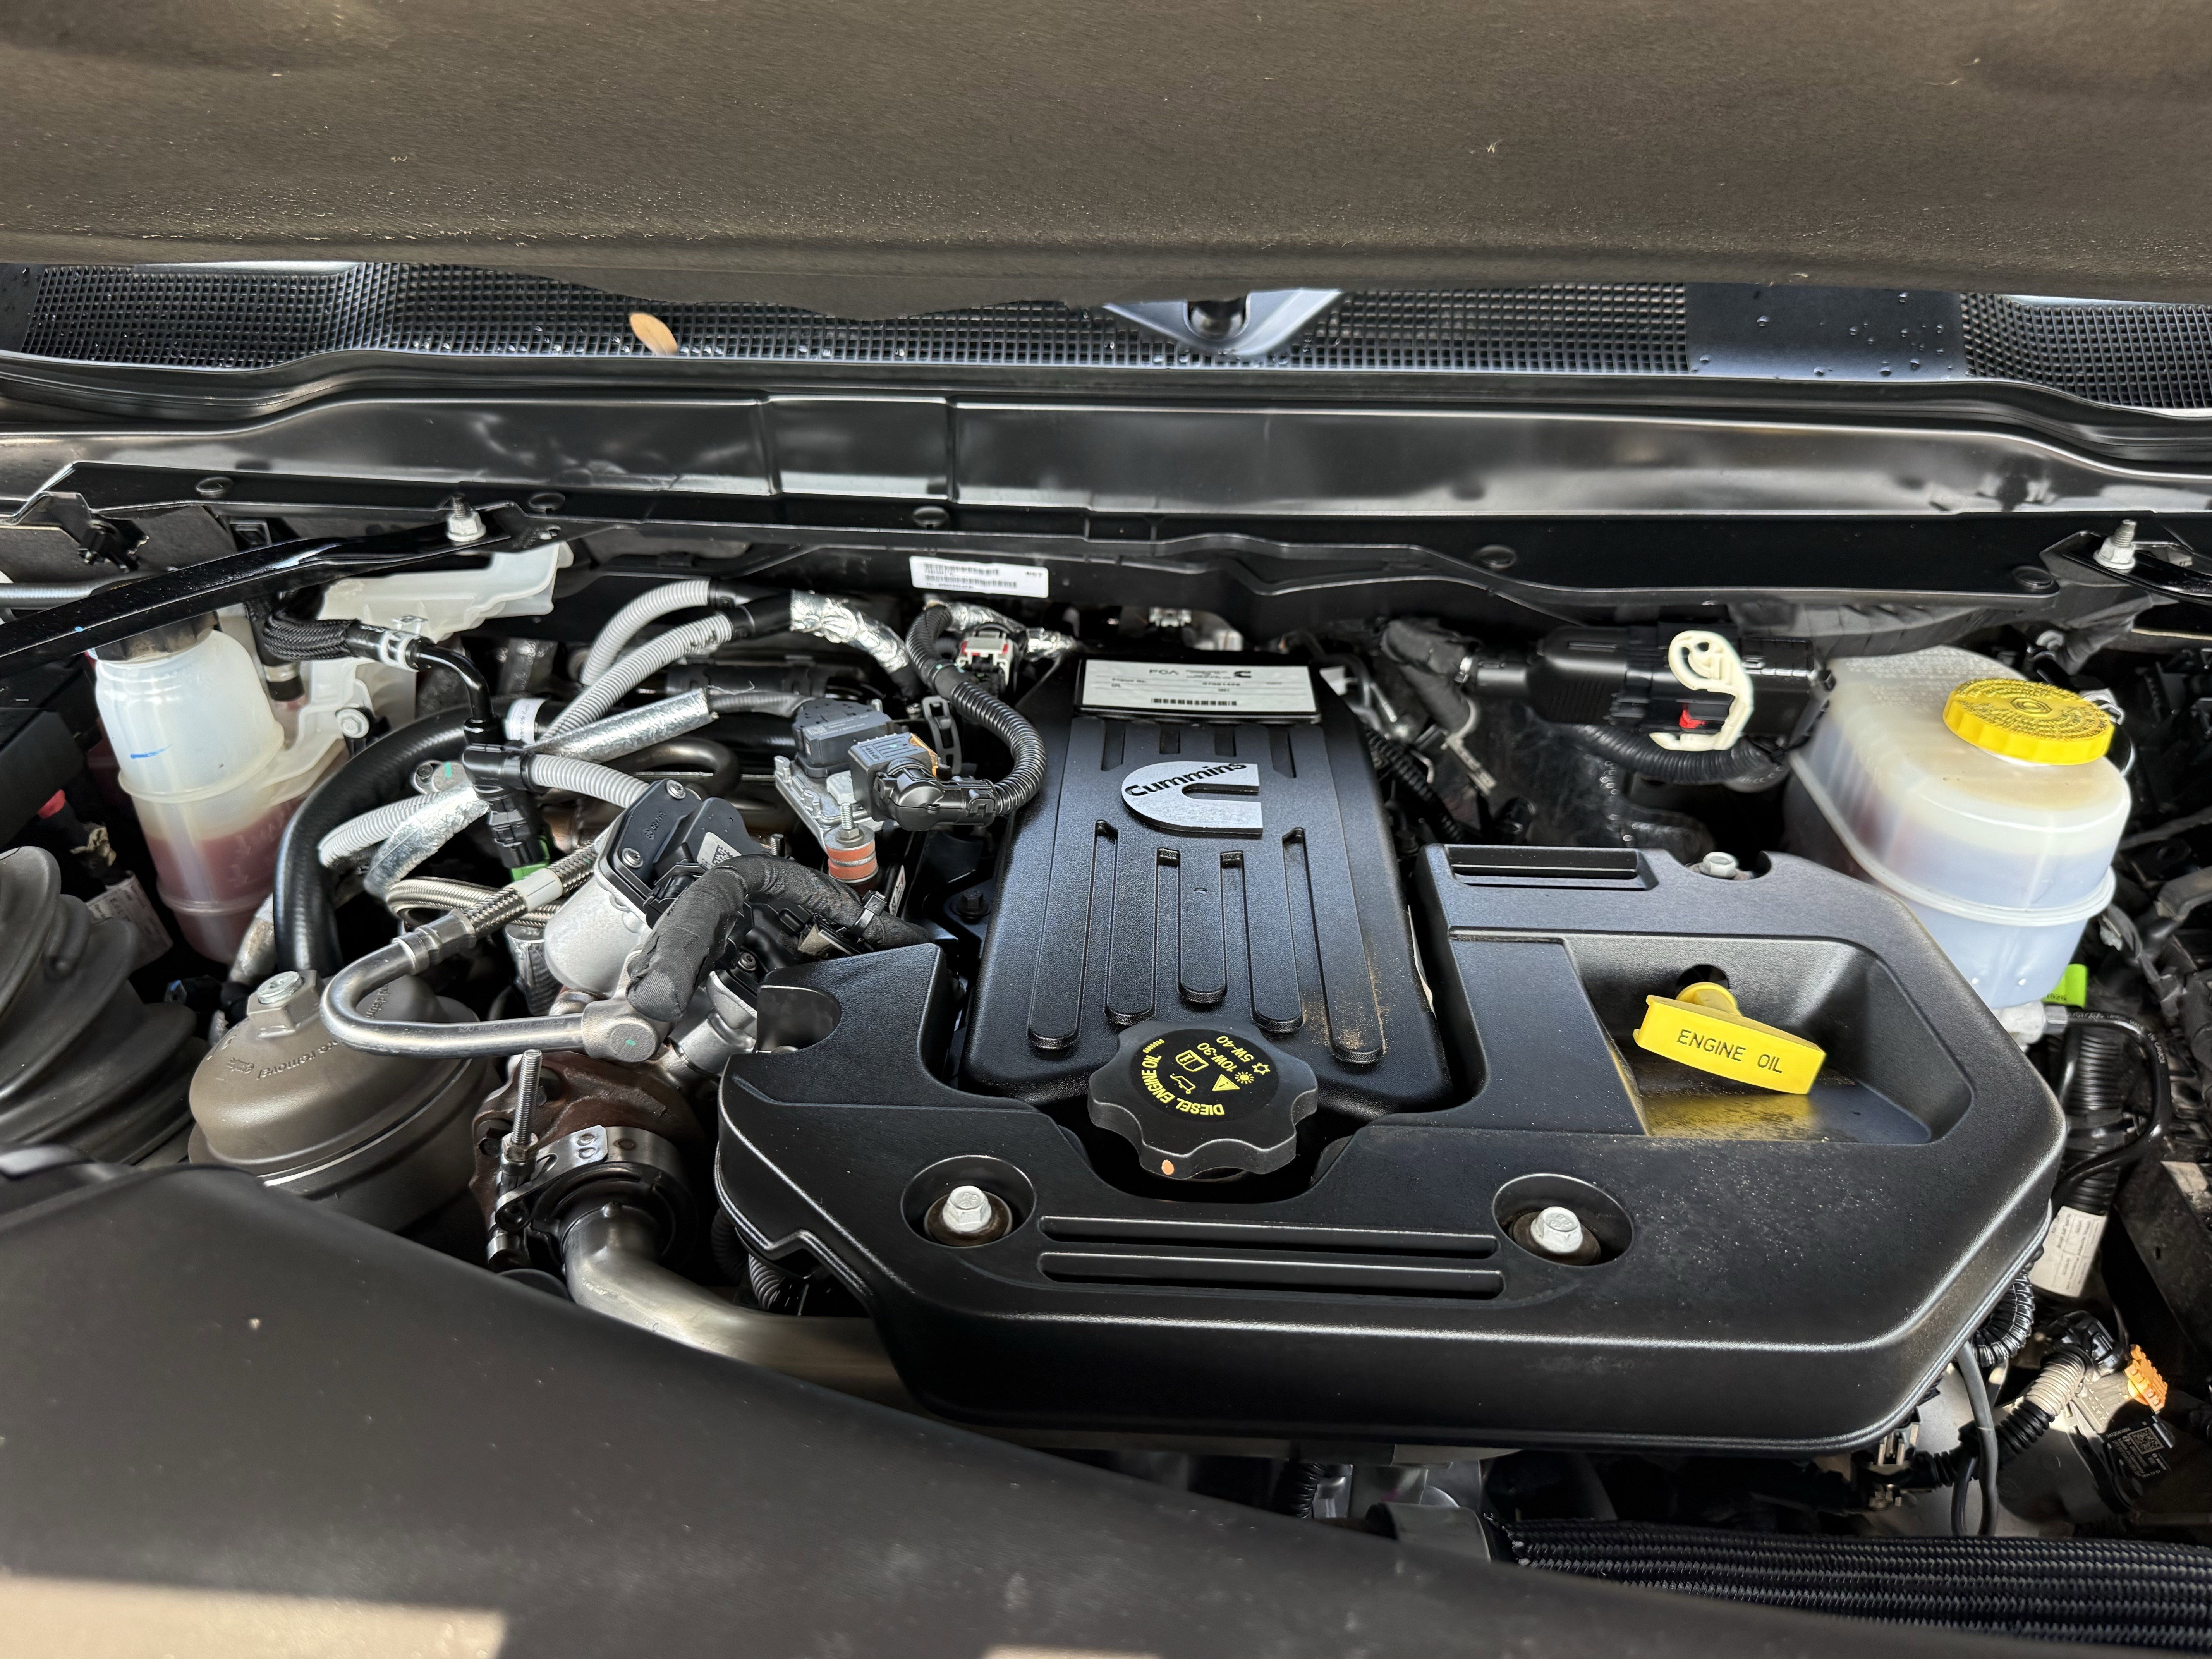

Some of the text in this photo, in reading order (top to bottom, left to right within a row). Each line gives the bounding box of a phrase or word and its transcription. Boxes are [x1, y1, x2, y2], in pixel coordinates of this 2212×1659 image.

[1125, 762, 1247, 796] Cummins
[1197, 1042, 1238, 1072] 10W-30
[1216, 1036, 1254, 1062] 5W-40
[1676, 1029, 1783, 1073] ENGINE OIL
[256, 1051, 316, 1081] removal
[1141, 1054, 1225, 1115] DIESEL ENGINE OIL
